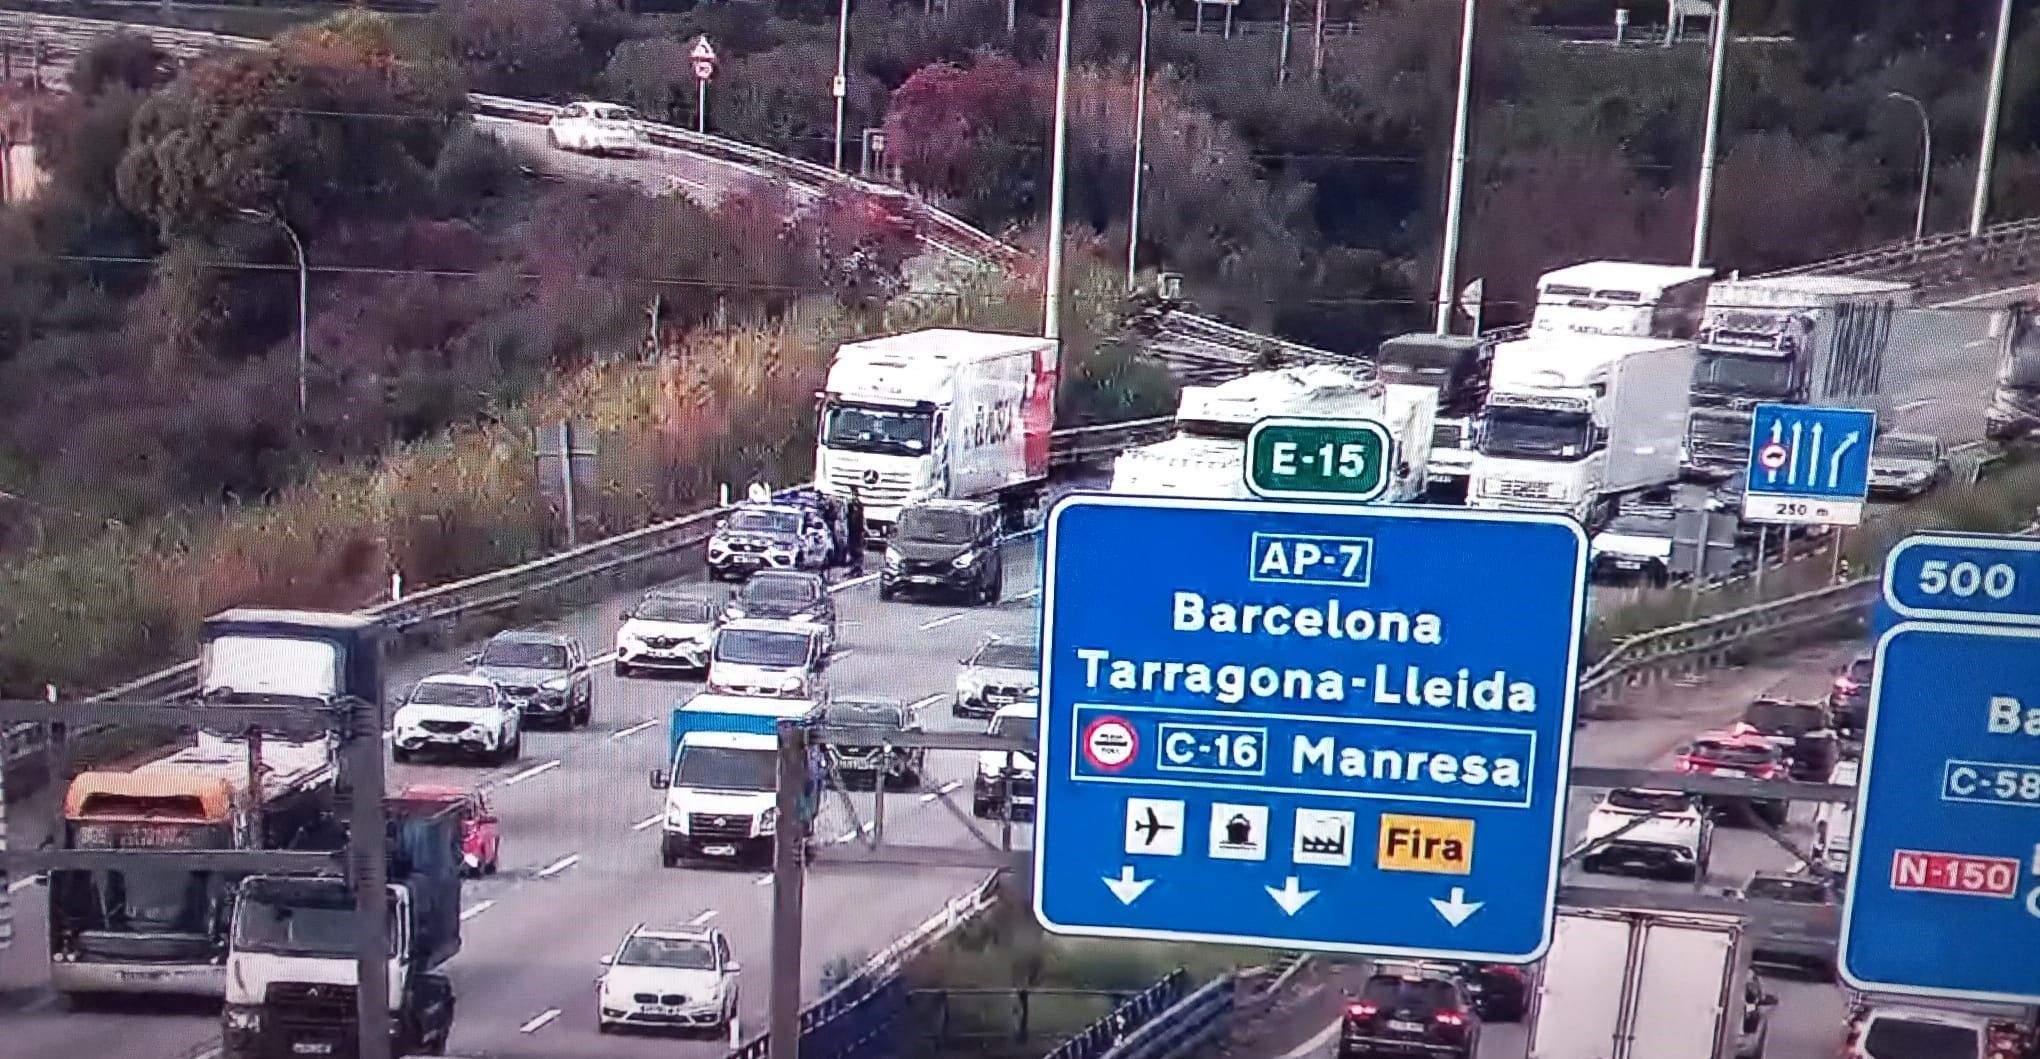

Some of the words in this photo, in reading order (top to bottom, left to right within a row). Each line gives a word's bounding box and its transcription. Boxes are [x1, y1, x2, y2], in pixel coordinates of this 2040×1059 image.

[1272, 441, 1365, 478] E-15
[1776, 503, 1807, 516] 250
[1259, 541, 1363, 578] AP-7
[1919, 559, 2016, 599] 500
[1172, 591, 1442, 646] Barcelona
[1076, 648, 1537, 713] Tarragona-Lleida
[1164, 731, 1259, 769] C-16
[1291, 734, 1521, 789] Manresa
[1950, 766, 2040, 801] C-58
[1387, 827, 1463, 862] Fira
[1899, 856, 2012, 891] N-150
